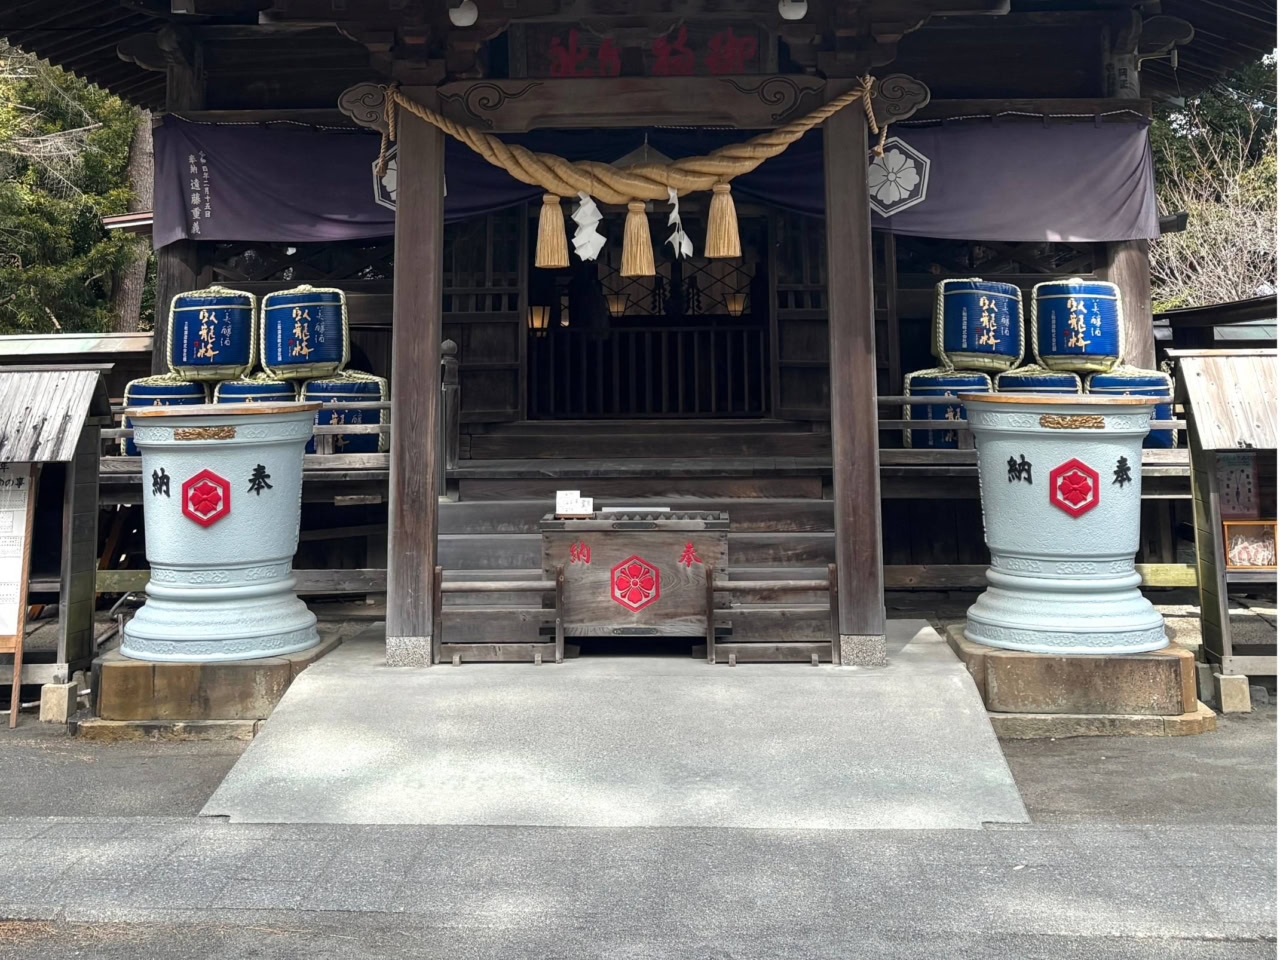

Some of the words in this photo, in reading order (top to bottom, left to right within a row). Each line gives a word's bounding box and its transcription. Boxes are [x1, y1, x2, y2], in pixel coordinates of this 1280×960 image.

[151, 467, 172, 499] 納
[247, 464, 274, 496] 奉
[1007, 455, 1033, 486] 納
[1112, 455, 1133, 488] 奉
[570, 540, 591, 564] 納
[677, 540, 703, 568] 奉
